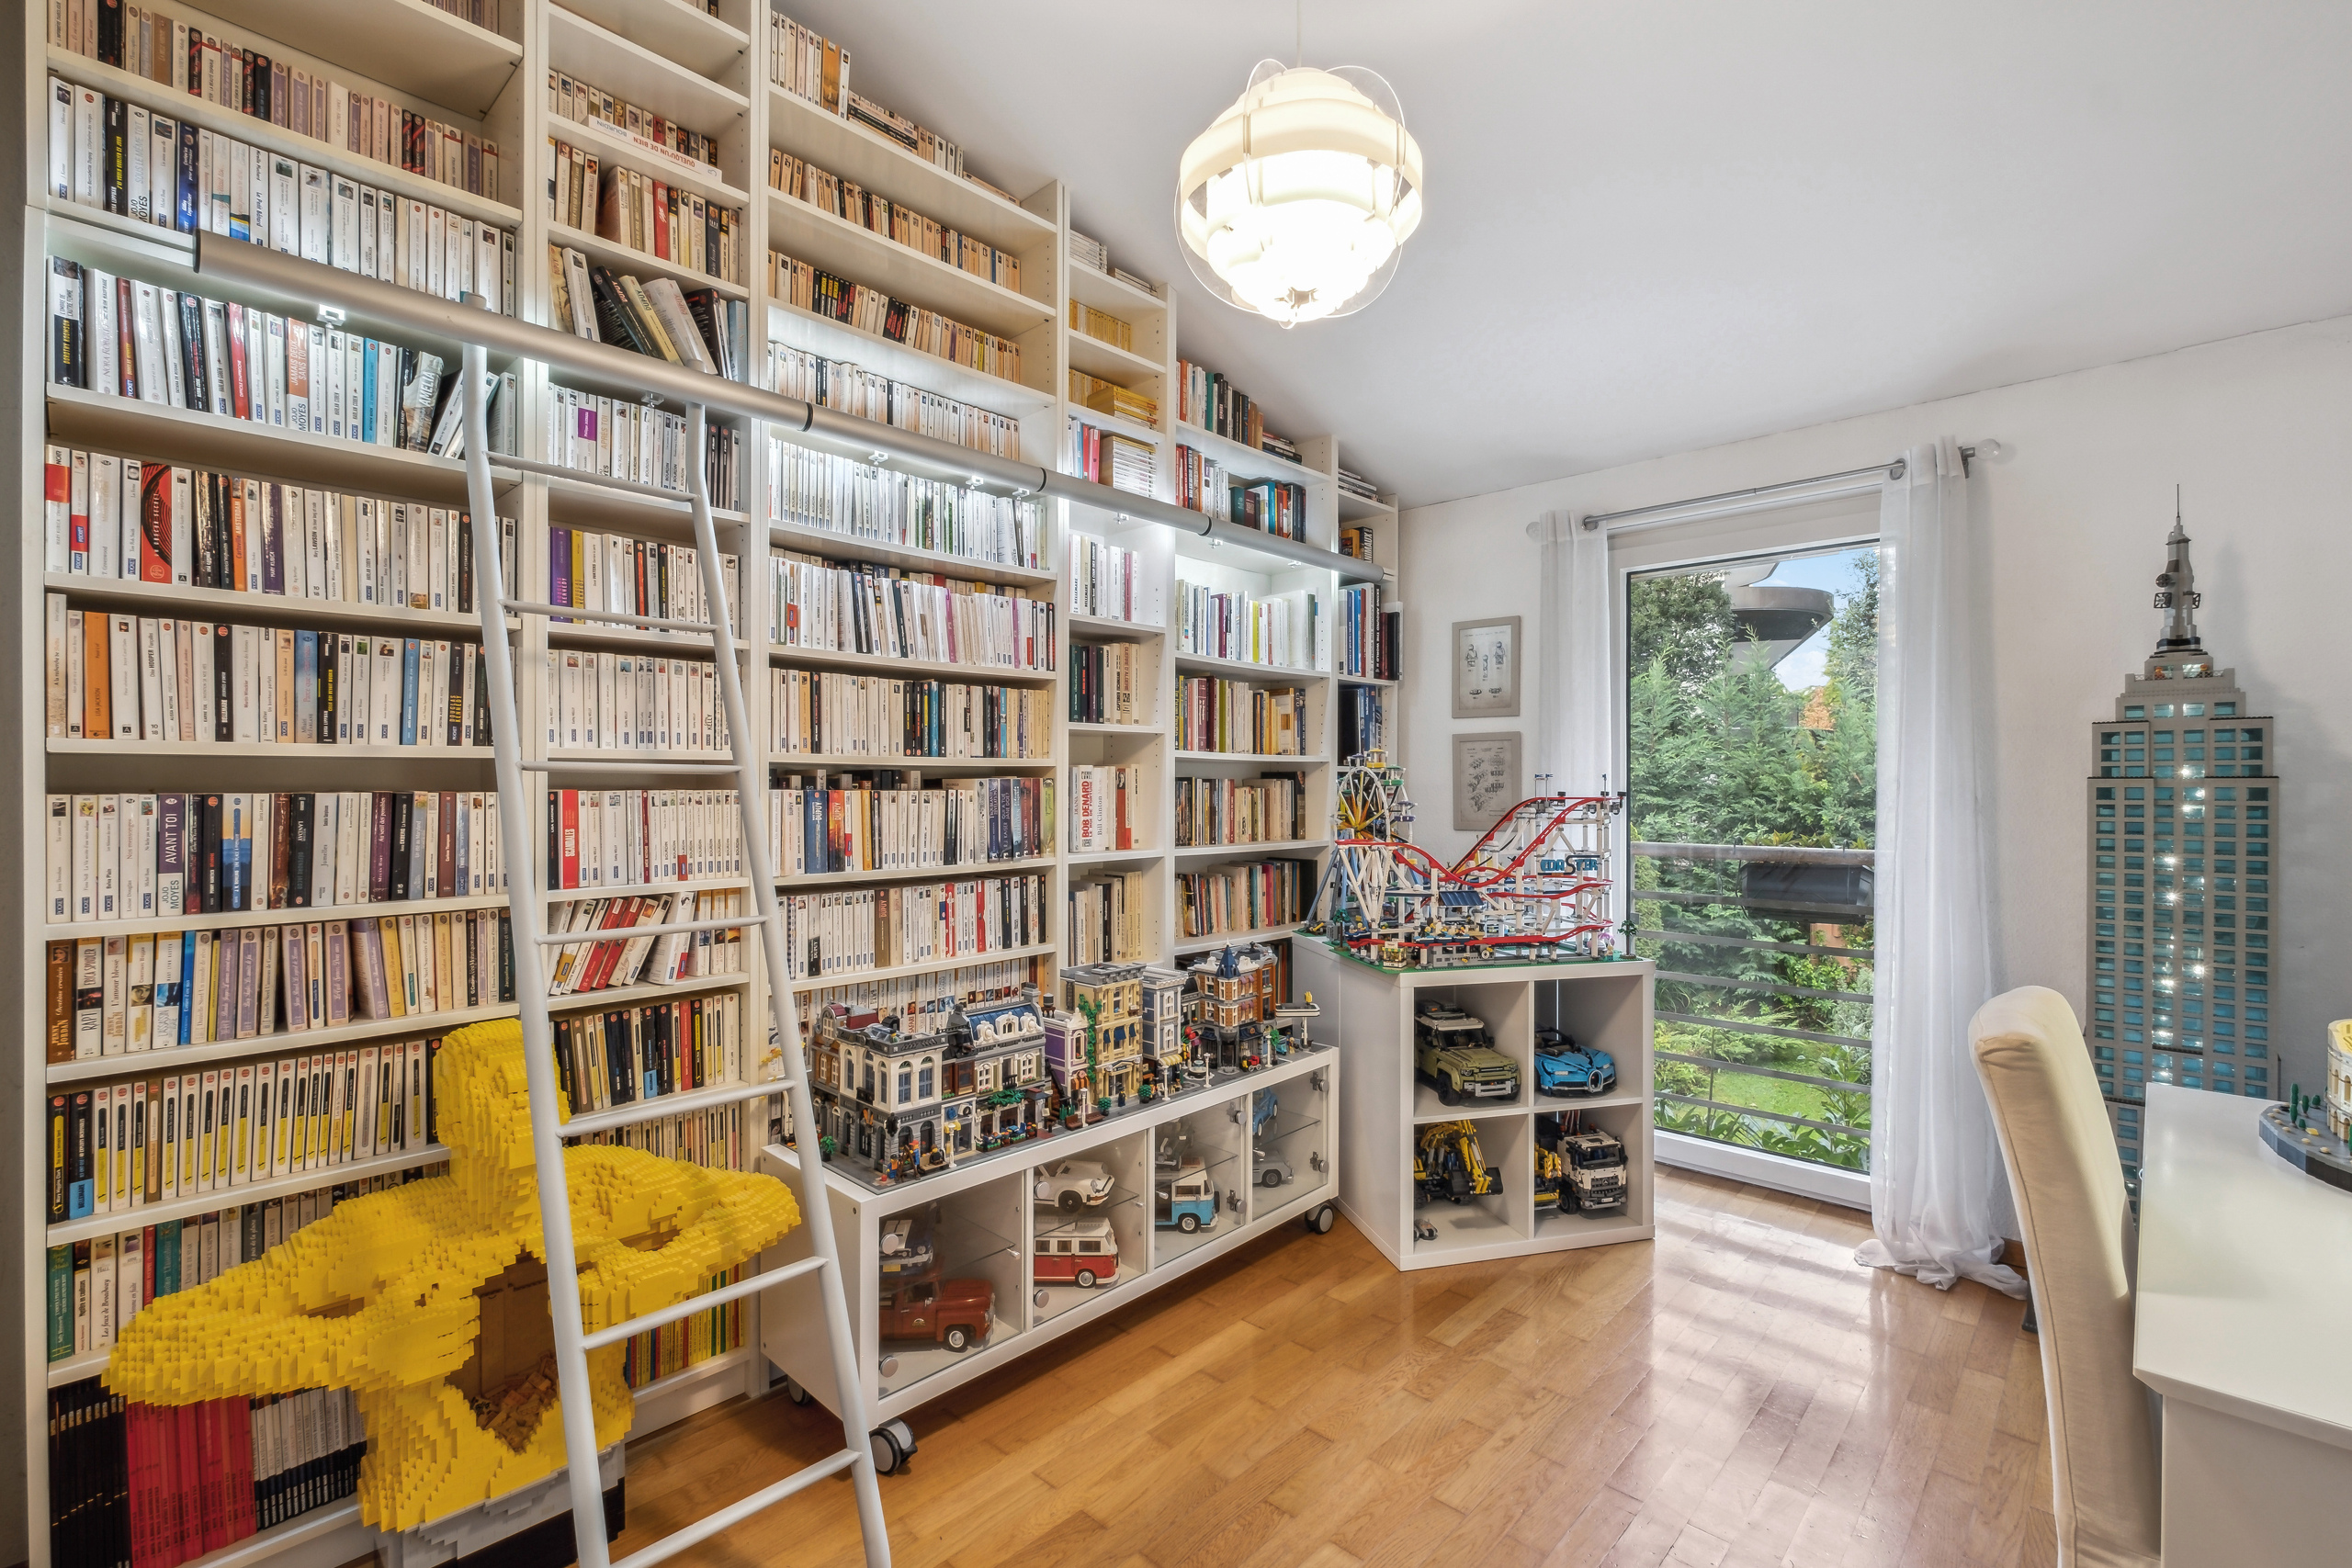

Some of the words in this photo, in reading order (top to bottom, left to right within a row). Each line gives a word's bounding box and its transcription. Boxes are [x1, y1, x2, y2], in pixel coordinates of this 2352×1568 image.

[633, 137, 649, 148] BIEN
[661, 148, 695, 168] QUELQU'UN
[612, 280, 628, 302] DUPUY
[636, 290, 651, 310] DUPUY
[290, 362, 299, 385] JAMAIS
[420, 371, 435, 406] AMELIA
[1081, 781, 1090, 817] DENARD
[165, 813, 177, 829] TOI
[1081, 819, 1090, 838] BOB
[165, 832, 177, 863] AVANT
[564, 829, 575, 857] SCANDALES
[170, 880, 179, 908] MOYES
[85, 949, 96, 971] SPINDLER
[84, 972, 96, 985] ERICA
[110, 980, 119, 1006] L'amour
[57, 1020, 69, 1045] JORDAN
[81, 1012, 98, 1031] RAPT
